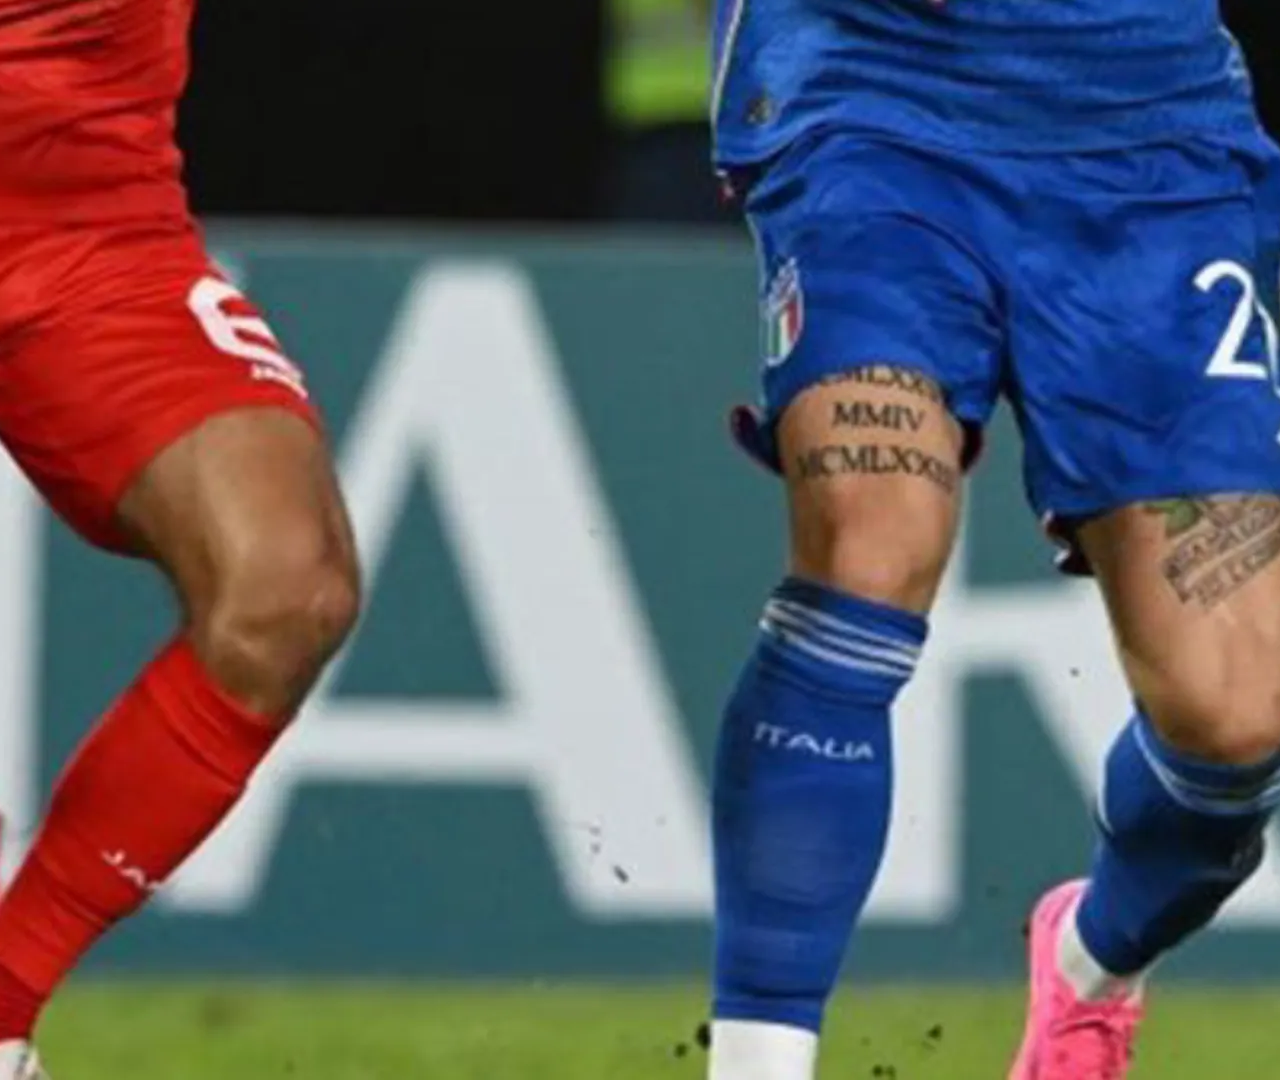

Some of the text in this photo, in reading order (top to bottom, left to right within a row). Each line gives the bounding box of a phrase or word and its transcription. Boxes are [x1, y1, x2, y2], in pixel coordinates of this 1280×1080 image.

[185, 277, 303, 383] 6
[832, 400, 926, 432] MMIV
[753, 721, 876, 762] ITALIA
